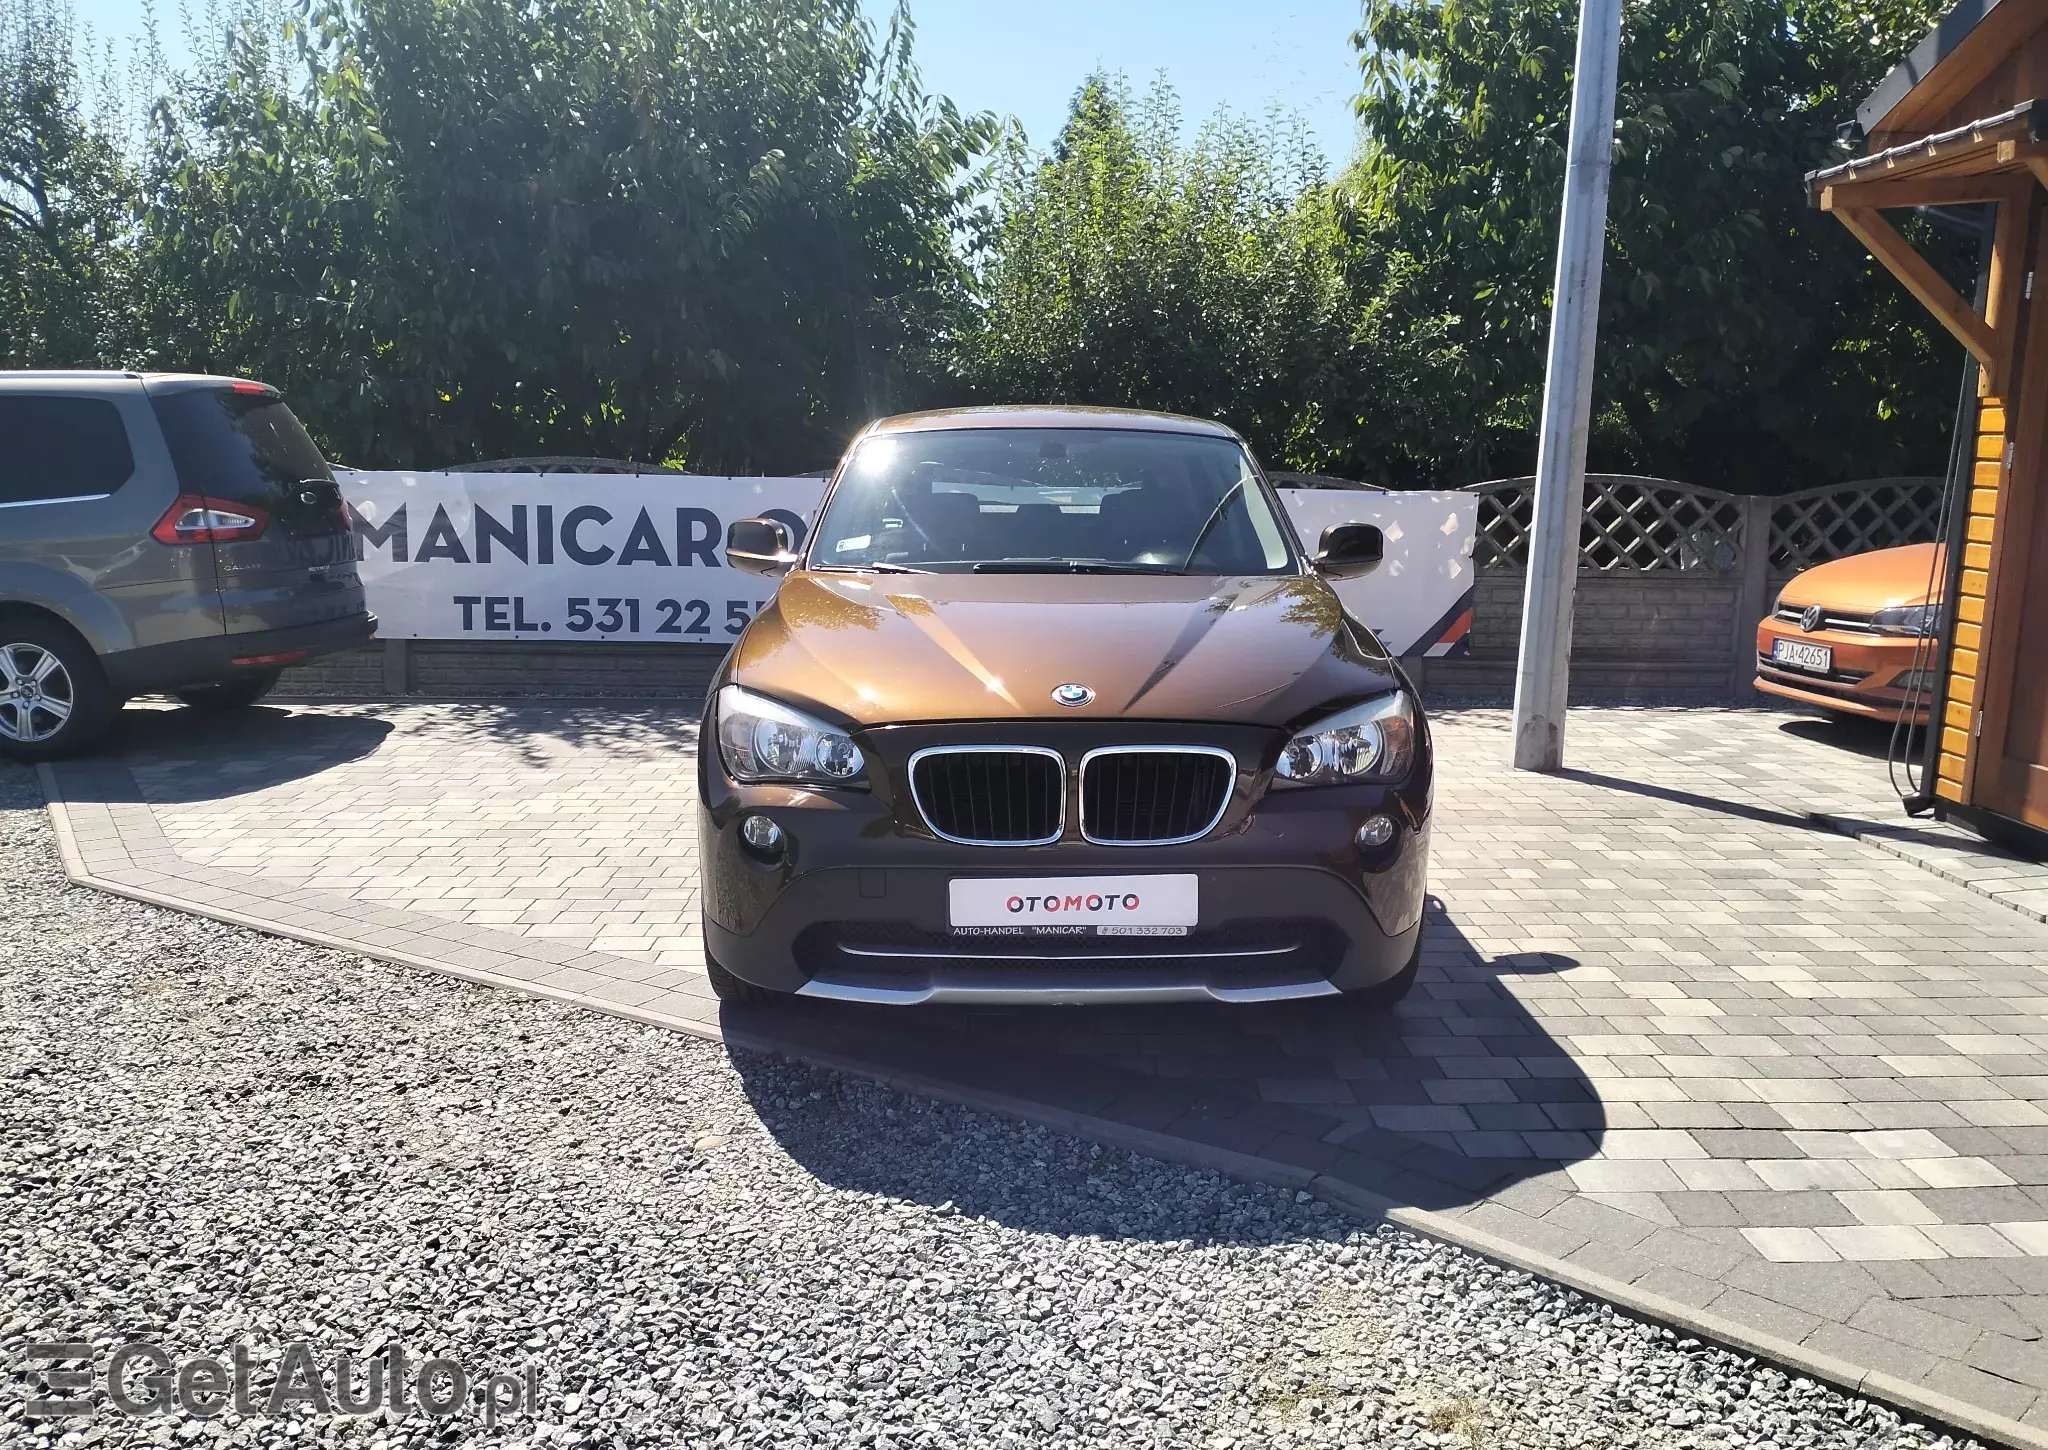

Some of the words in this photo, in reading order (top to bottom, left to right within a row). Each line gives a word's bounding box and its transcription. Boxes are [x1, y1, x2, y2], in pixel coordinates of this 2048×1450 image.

[453, 596, 551, 632] TEL.
[566, 597, 640, 633] 531
[655, 599, 711, 634] 22
[723, 600, 766, 635] 5
[1006, 893, 1140, 913] OTOMOTO
[953, 927, 1024, 936] AUTO-HANDEL
[1031, 926, 1087, 935] "MANICAR"
[1111, 927, 1133, 935] 501
[1136, 927, 1158, 935] 332
[1161, 927, 1183, 935] 703
